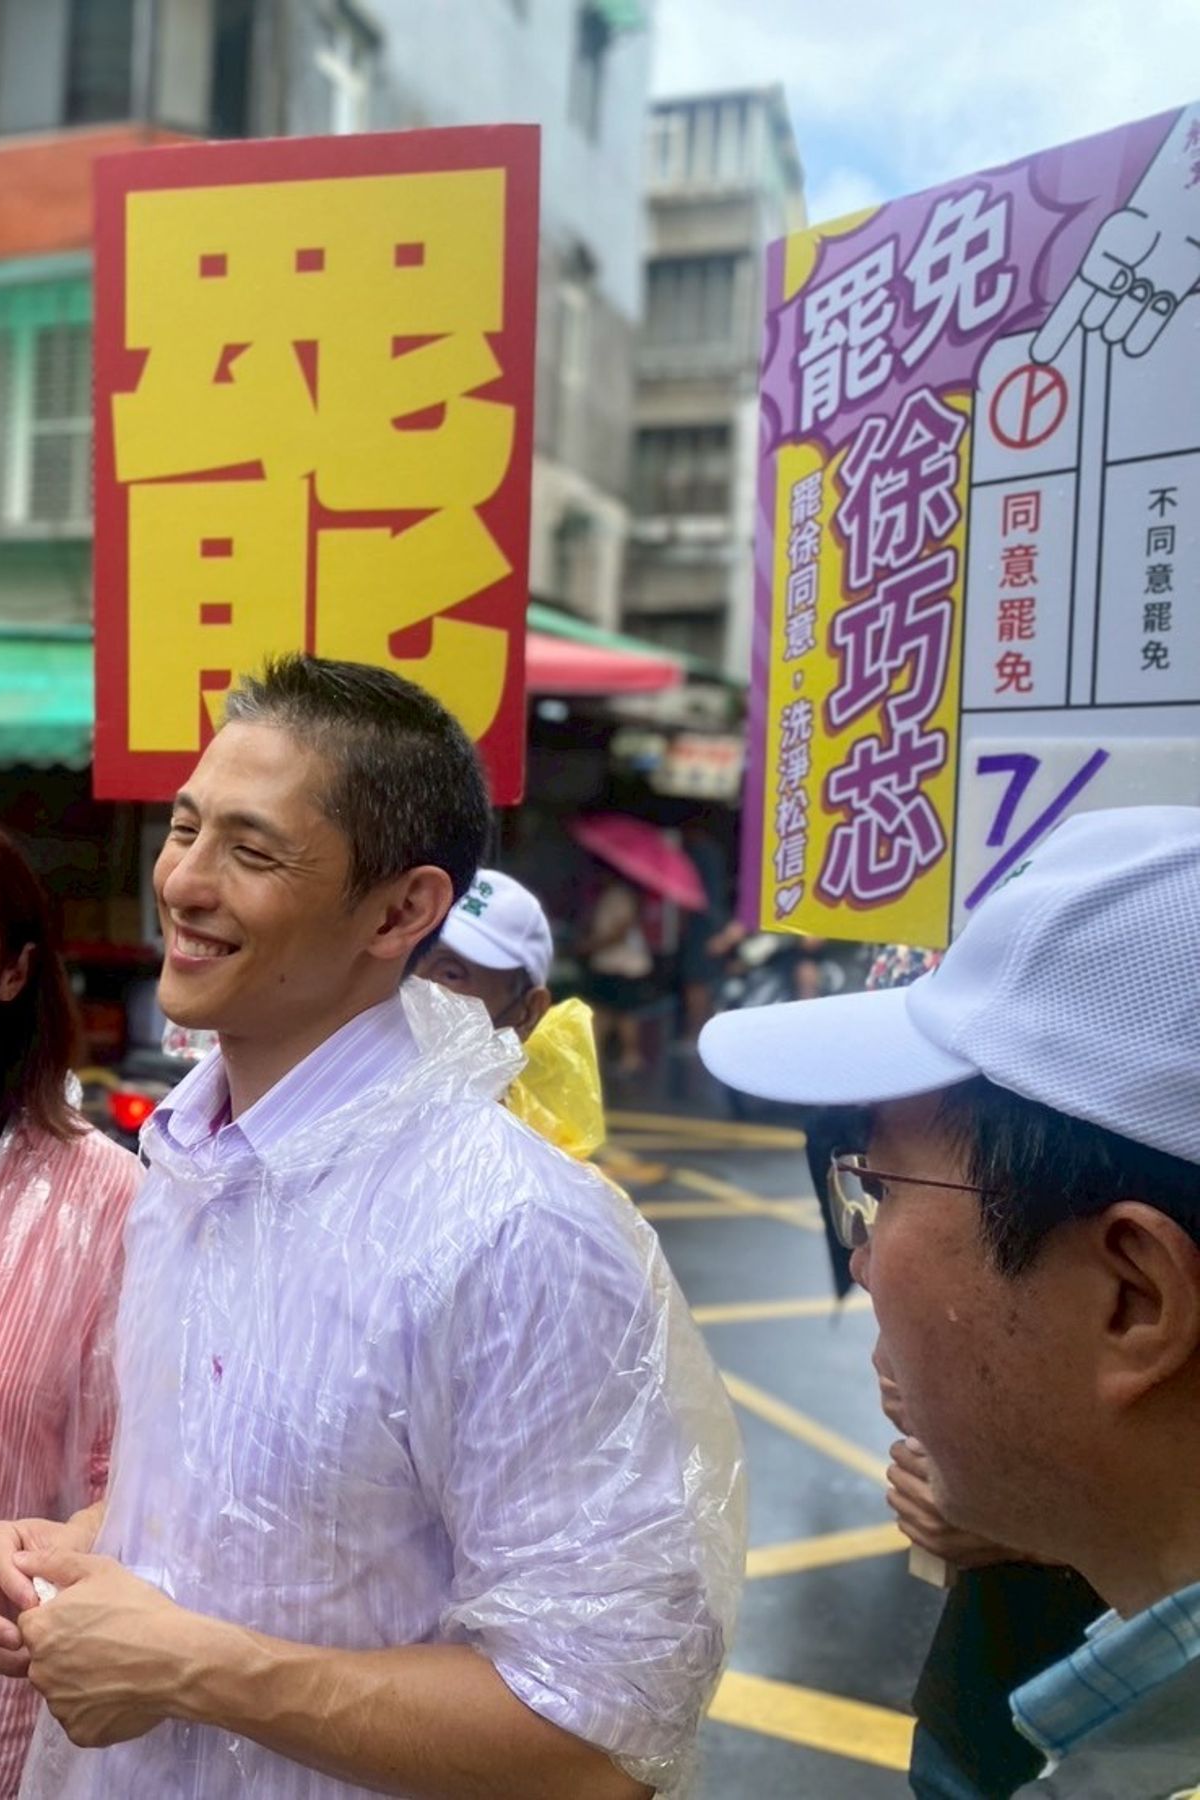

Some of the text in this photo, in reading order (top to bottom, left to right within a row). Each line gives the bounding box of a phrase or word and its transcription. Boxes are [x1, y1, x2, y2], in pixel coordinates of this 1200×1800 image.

[798, 187, 1013, 432] 罷免
[111, 167, 516, 752] 罷
[1140, 486, 1178, 672] 不同意罷免
[820, 388, 968, 900] 徐巧芯
[994, 489, 1042, 695] 同意罷免
